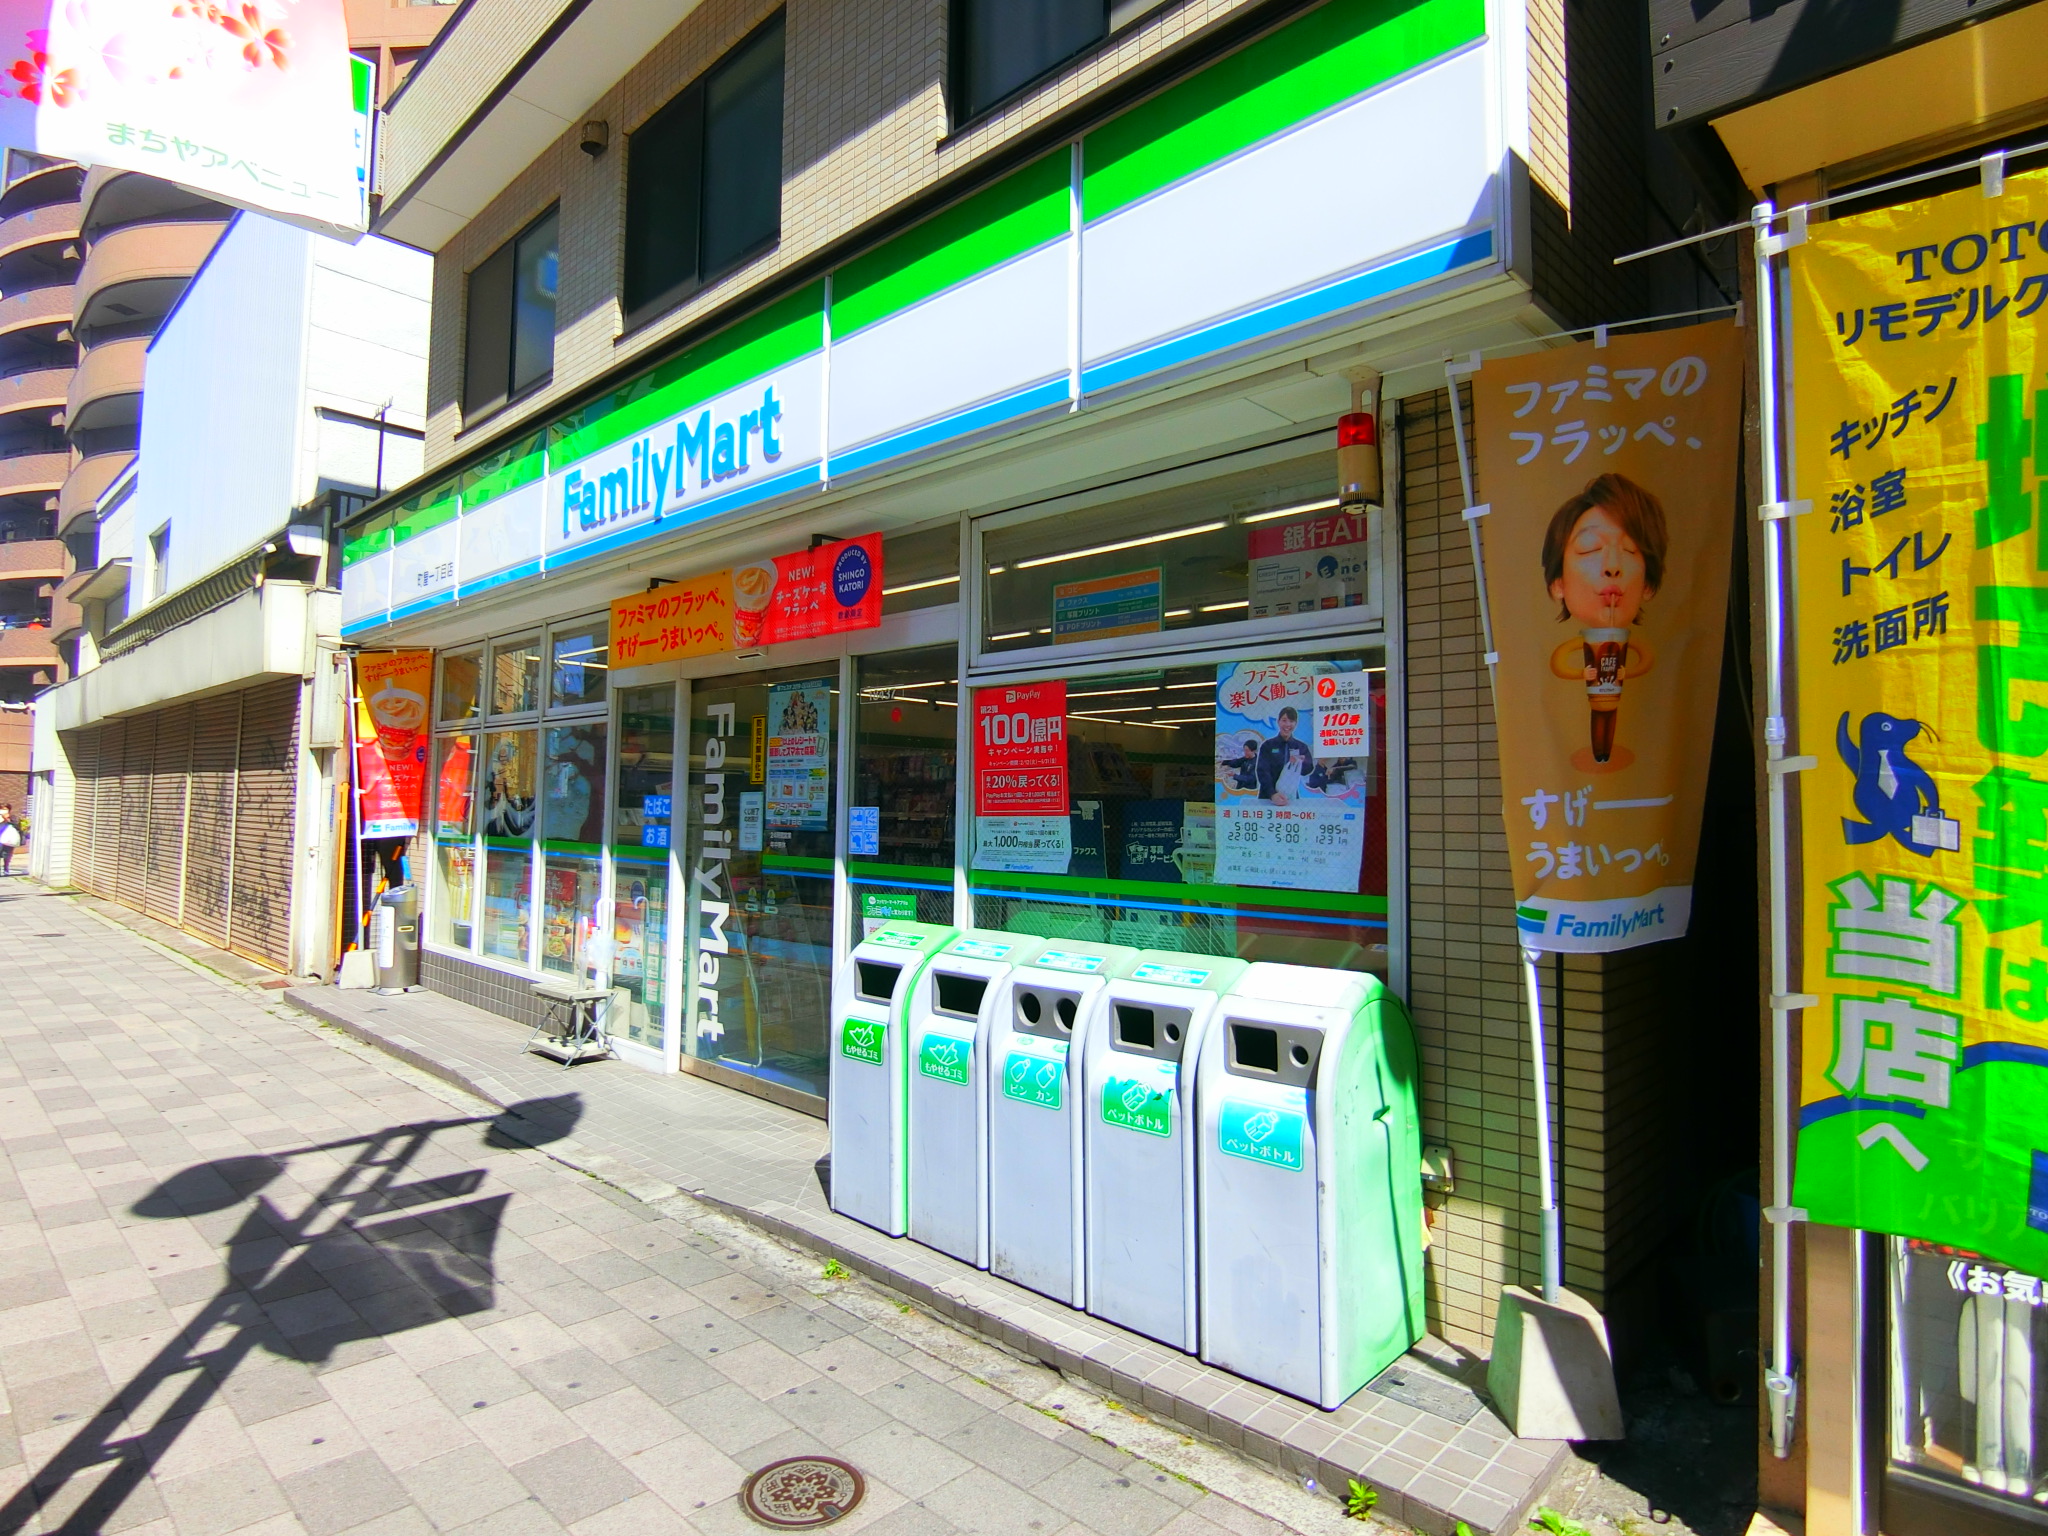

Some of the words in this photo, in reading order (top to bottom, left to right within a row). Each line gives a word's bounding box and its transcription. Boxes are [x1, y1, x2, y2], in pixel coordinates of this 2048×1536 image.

[106, 121, 341, 200] まちやアベニュー
[1896, 218, 2048, 284] TOT
[1505, 356, 1708, 418] ファミマの
[1829, 376, 1958, 461] キッチン
[1508, 415, 1702, 466] フラッペ、
[562, 385, 785, 539] FamilyMart
[1829, 466, 1908, 535] 浴室
[788, 565, 815, 583] NEW!
[837, 568, 865, 583] SHINGO
[1841, 529, 1953, 598] トイレ
[776, 581, 828, 606] チーズケーキ
[838, 580, 864, 593] KATORI
[617, 586, 726, 629] ファミマのフラッペ、
[784, 600, 819, 619] フラッペ
[1832, 590, 1950, 667] 洗面所
[1243, 662, 1300, 687] ファミマで
[1600, 656, 1617, 668] CAFE
[1017, 690, 1041, 701] PayPay
[1229, 675, 1315, 709] 楽しく働こう!
[1340, 680, 1354, 688] この
[980, 712, 1063, 746] 100億円
[1322, 712, 1361, 727] 110番
[1319, 728, 1364, 738] 通報のご協力を
[1322, 737, 1361, 747] お願いします
[389, 764, 414, 772] NEW!
[644, 798, 671, 816] たばこ
[645, 827, 668, 846] お酒
[1073, 846, 1098, 856] ファクス
[1525, 838, 1669, 880] うまいっぺ。
[694, 702, 736, 1042] FamilyMart
[1555, 902, 1665, 939] FamilyMart
[1826, 871, 1965, 1173] 当店へ
[845, 1044, 879, 1061] もやせるゴミ
[924, 1062, 963, 1080] もやせるゴミ
[1010, 1083, 1028, 1096] ビン
[1035, 1089, 1054, 1102] カン
[1107, 1108, 1164, 1131] ペットボトル
[1226, 1138, 1295, 1164] ペットボトル
